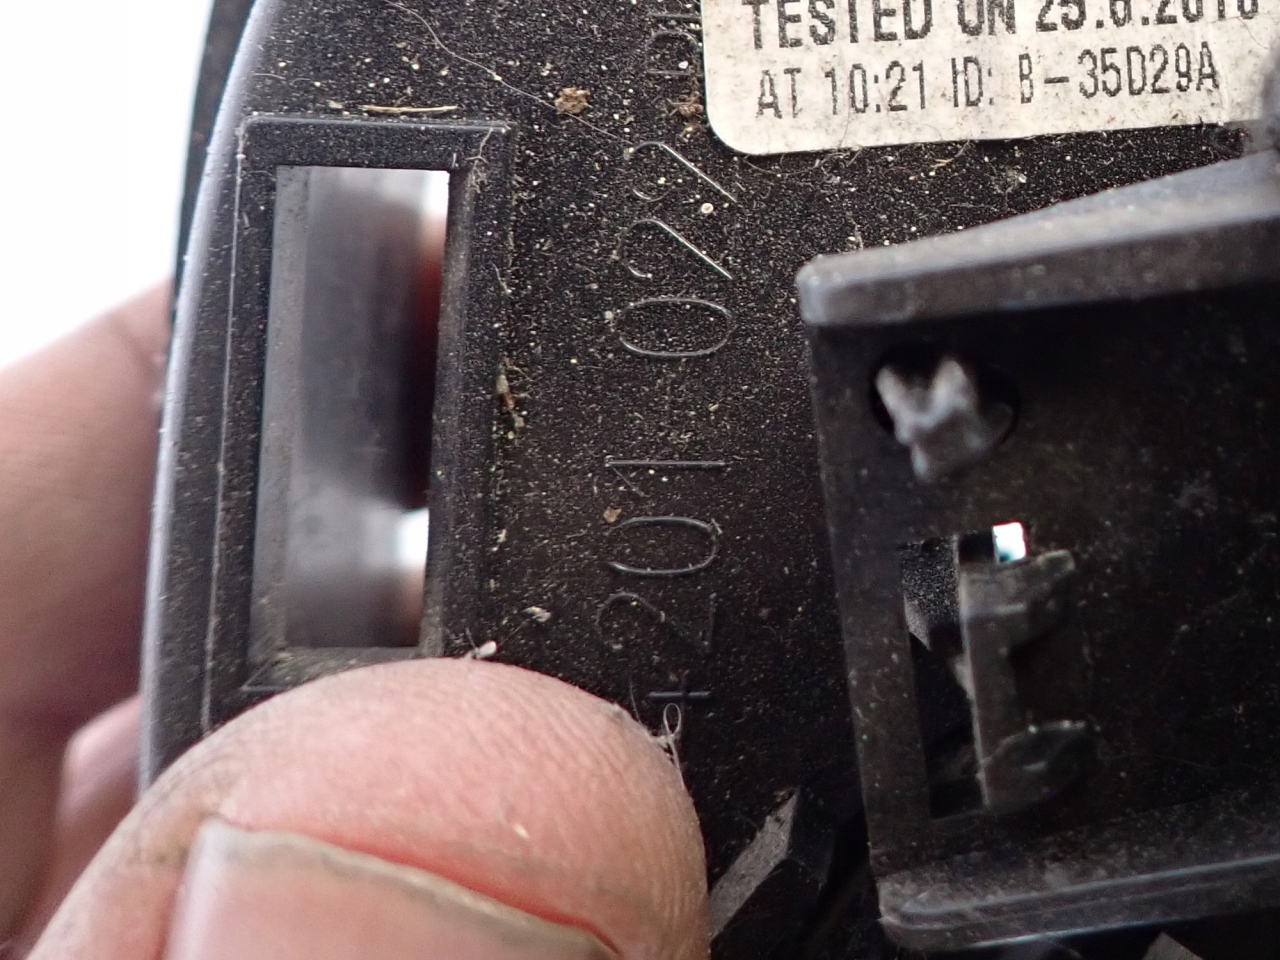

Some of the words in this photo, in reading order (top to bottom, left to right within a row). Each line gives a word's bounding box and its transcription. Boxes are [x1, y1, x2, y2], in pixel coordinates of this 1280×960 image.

[756, 67, 802, 119] AT
[824, 59, 926, 114] 10:21
[950, 55, 995, 108] ID:
